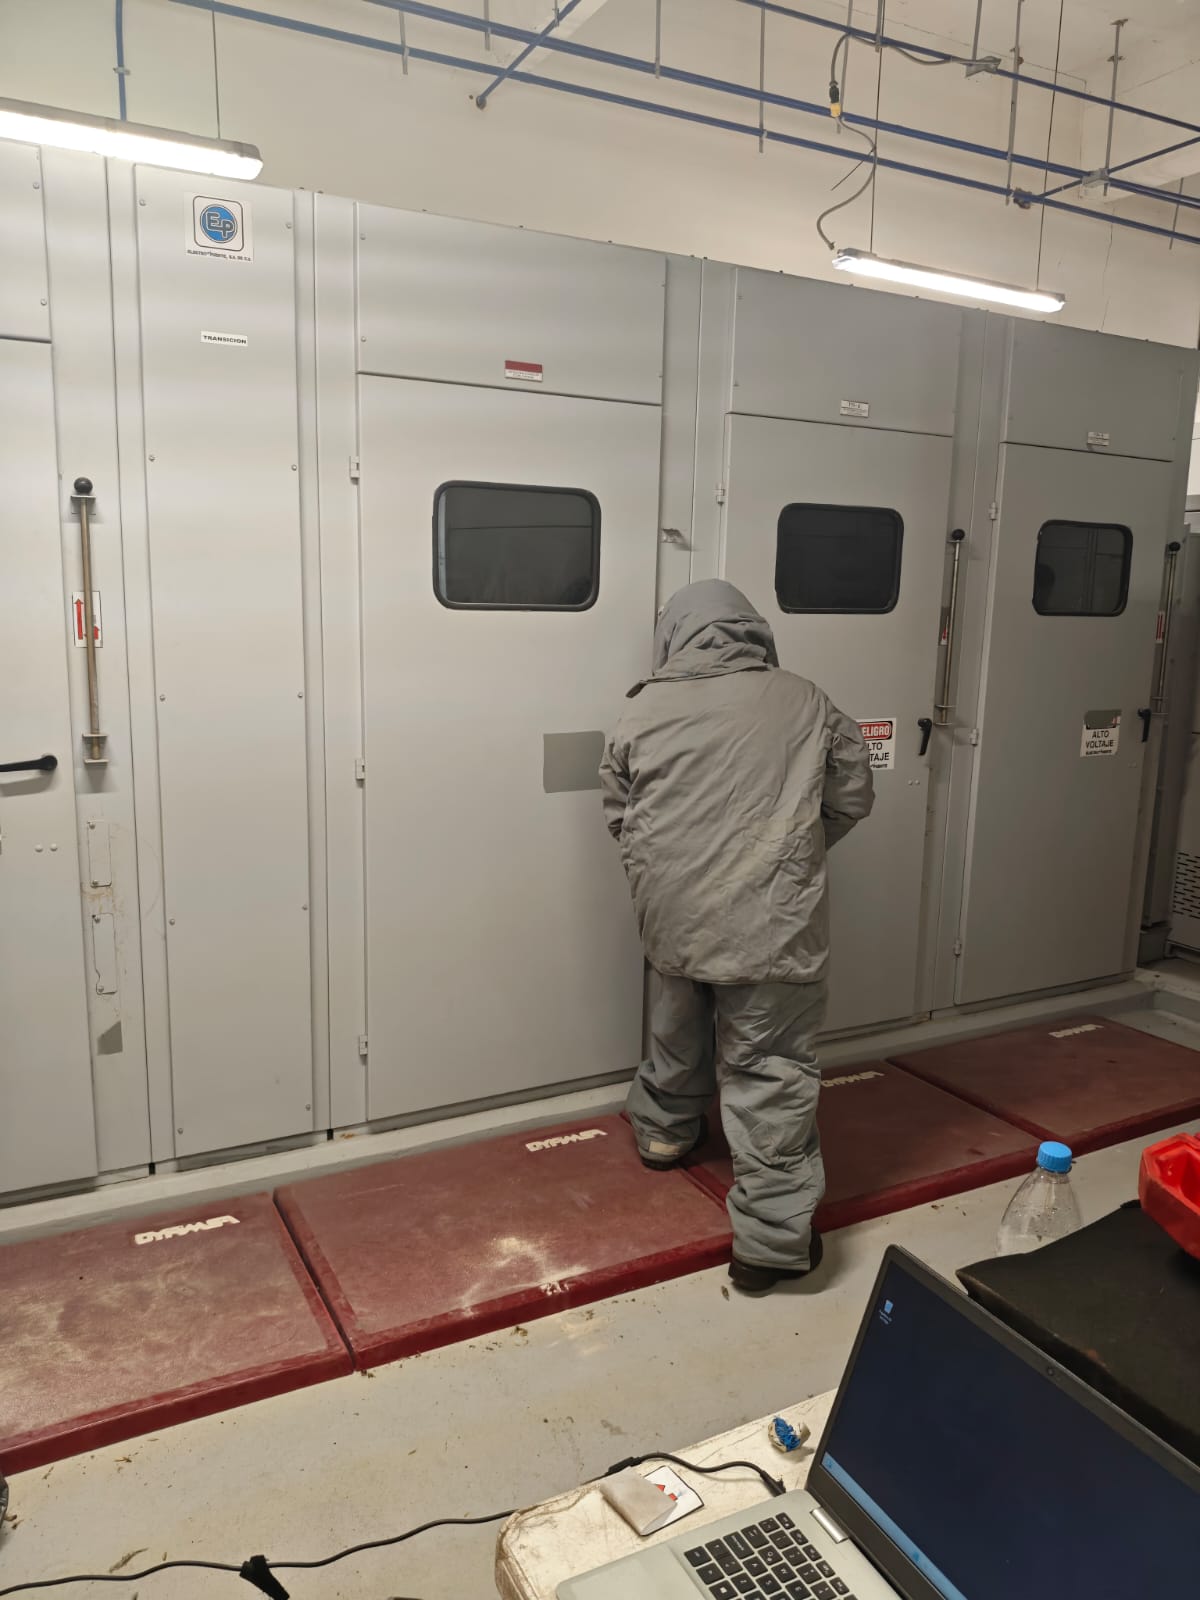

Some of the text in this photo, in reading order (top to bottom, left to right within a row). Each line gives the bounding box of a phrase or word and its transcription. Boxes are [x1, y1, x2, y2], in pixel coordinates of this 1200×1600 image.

[203, 335, 246, 344] TRANSICION
[861, 726, 889, 736] ELIGRO
[1092, 730, 1109, 738] ALTO
[867, 742, 882, 750] LTO
[1086, 740, 1113, 748] VOLTAJE
[869, 752, 889, 761] TAJE
